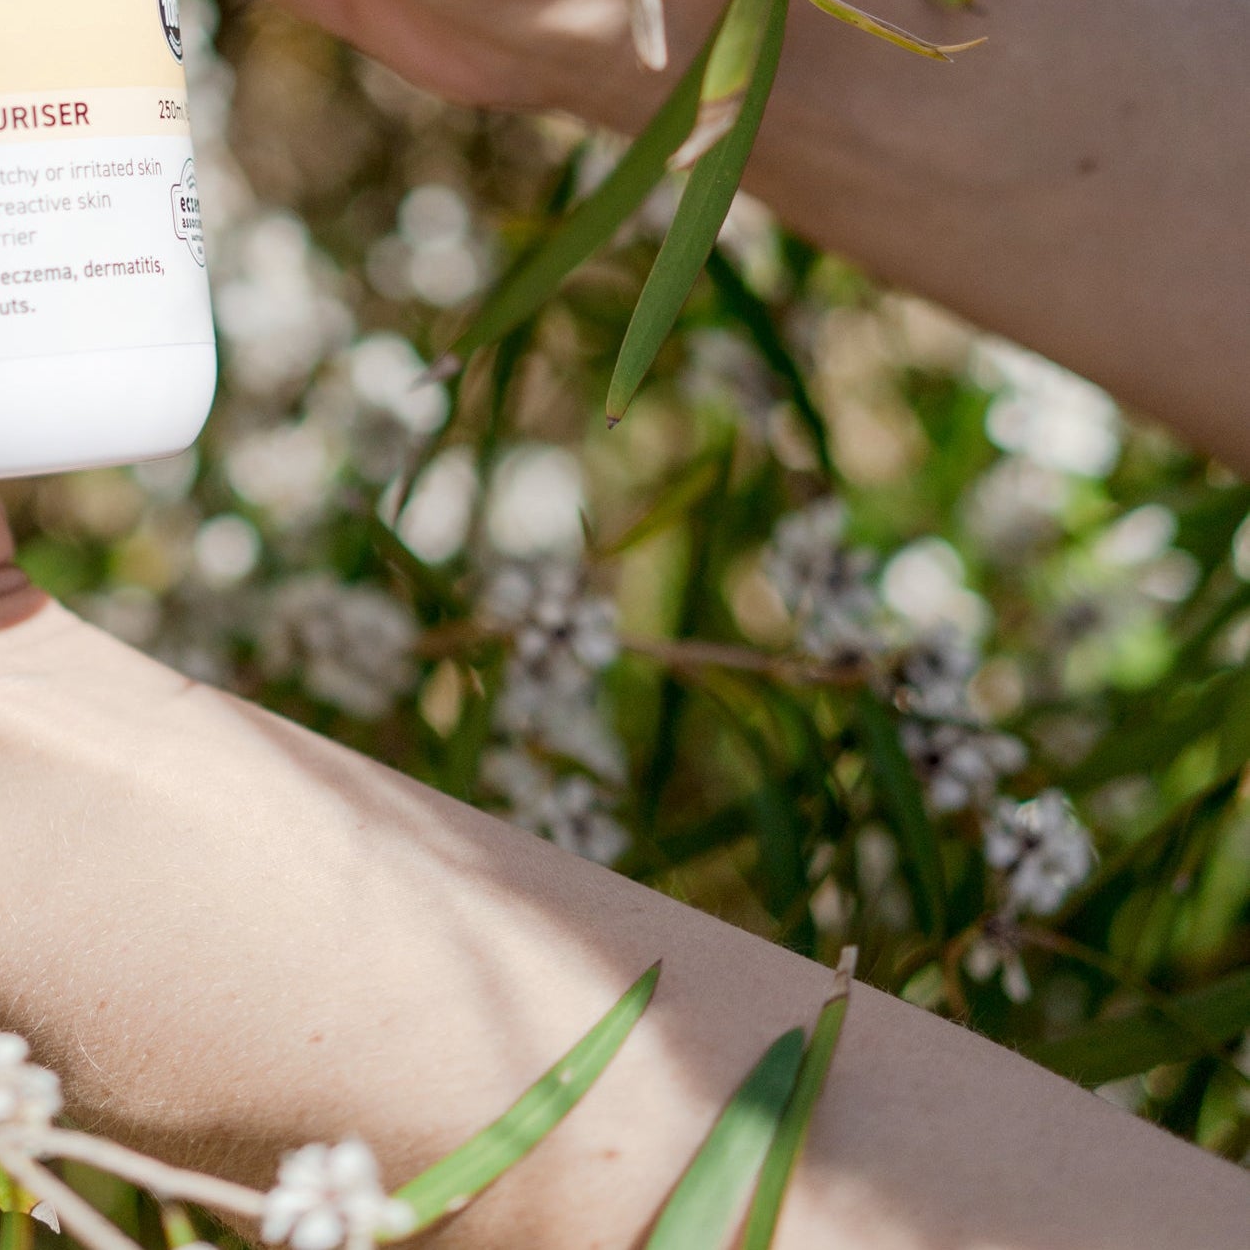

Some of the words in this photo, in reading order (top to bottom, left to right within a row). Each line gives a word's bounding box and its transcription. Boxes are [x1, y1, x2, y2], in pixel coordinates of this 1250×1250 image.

[45, 166, 64, 182] or
[70, 159, 134, 179] irritated
[138, 158, 162, 176] skin
[77, 191, 112, 210] skin
[1, 266, 78, 285] eczema,
[84, 257, 165, 278] dermatitis,
